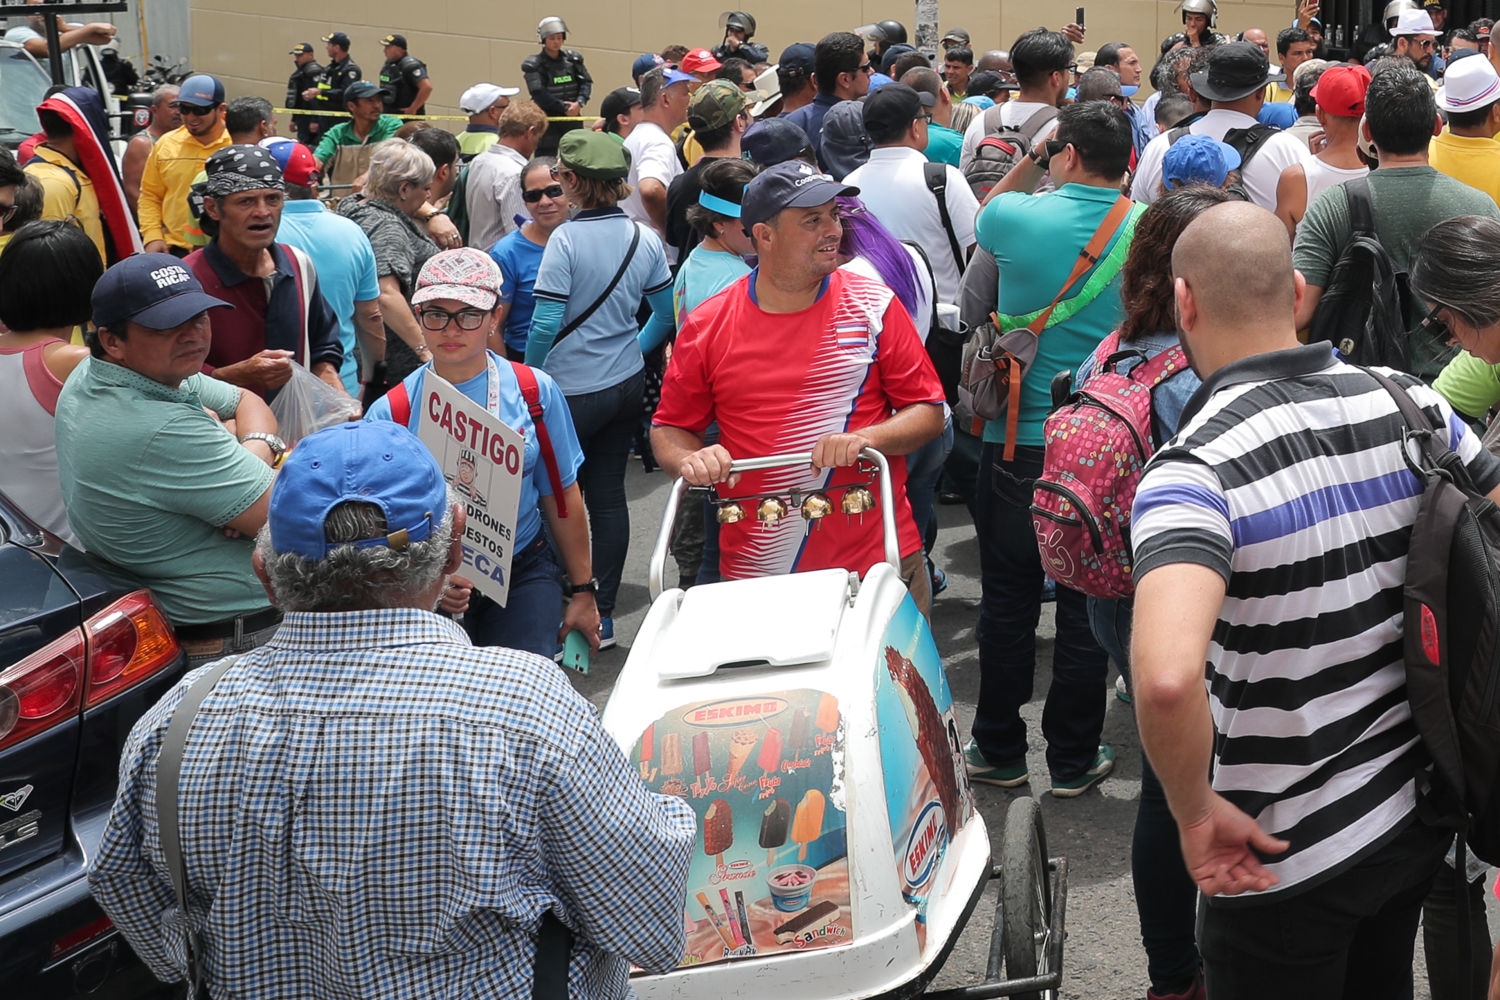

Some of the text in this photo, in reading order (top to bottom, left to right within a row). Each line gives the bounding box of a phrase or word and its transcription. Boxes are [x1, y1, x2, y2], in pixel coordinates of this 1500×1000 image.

[553, 75, 572, 84] POLICIA
[150, 265, 187, 280] COSTA
[156, 274, 188, 289] RICA
[428, 391, 520, 475] CASTIGO
[465, 503, 512, 541] DRONES
[461, 525, 504, 558] UESTOS
[462, 547, 505, 587] ECA
[694, 702, 777, 722] ESKIMO
[793, 924, 846, 948] Sandwich
